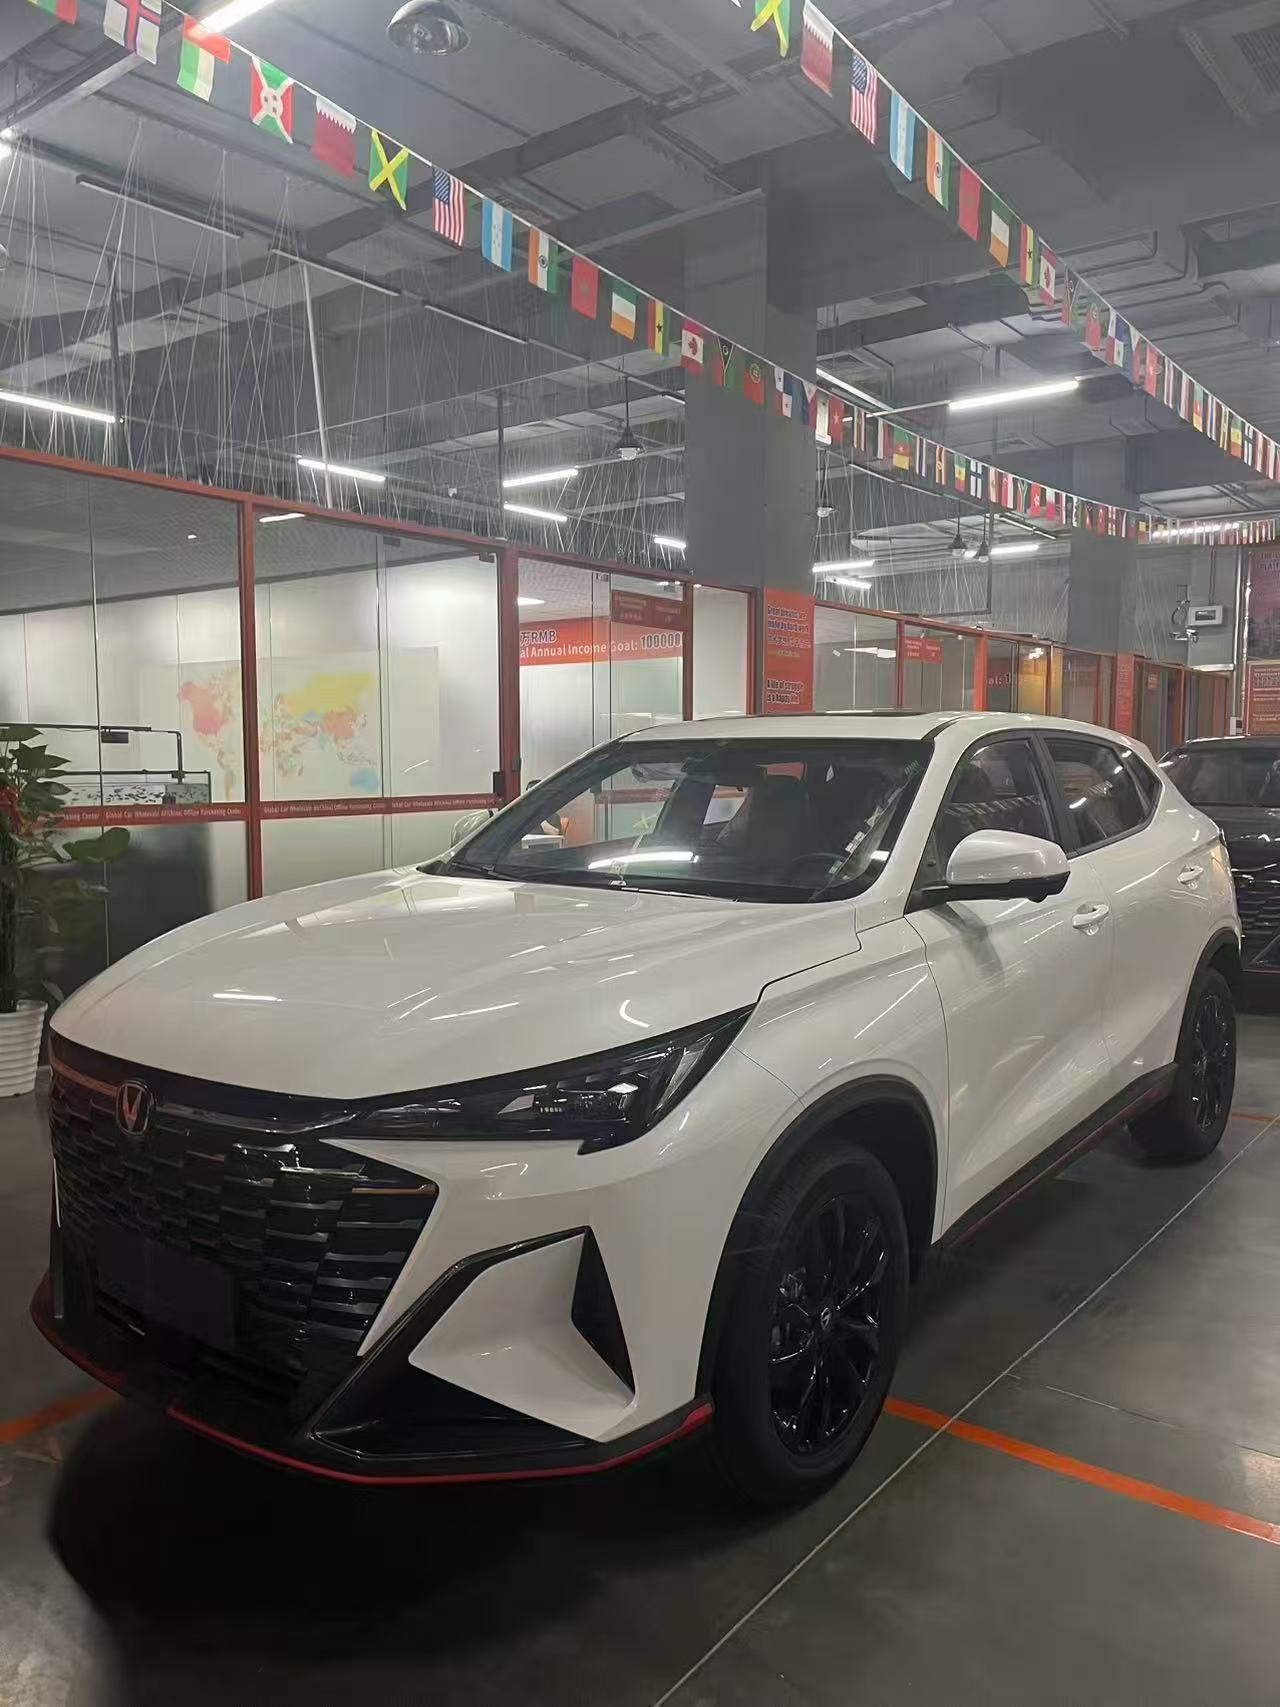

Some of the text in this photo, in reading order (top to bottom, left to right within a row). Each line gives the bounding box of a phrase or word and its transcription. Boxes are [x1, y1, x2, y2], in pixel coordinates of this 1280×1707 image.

[531, 645, 566, 658] Annual
[568, 642, 607, 655] Income
[610, 639, 638, 652] Goal:
